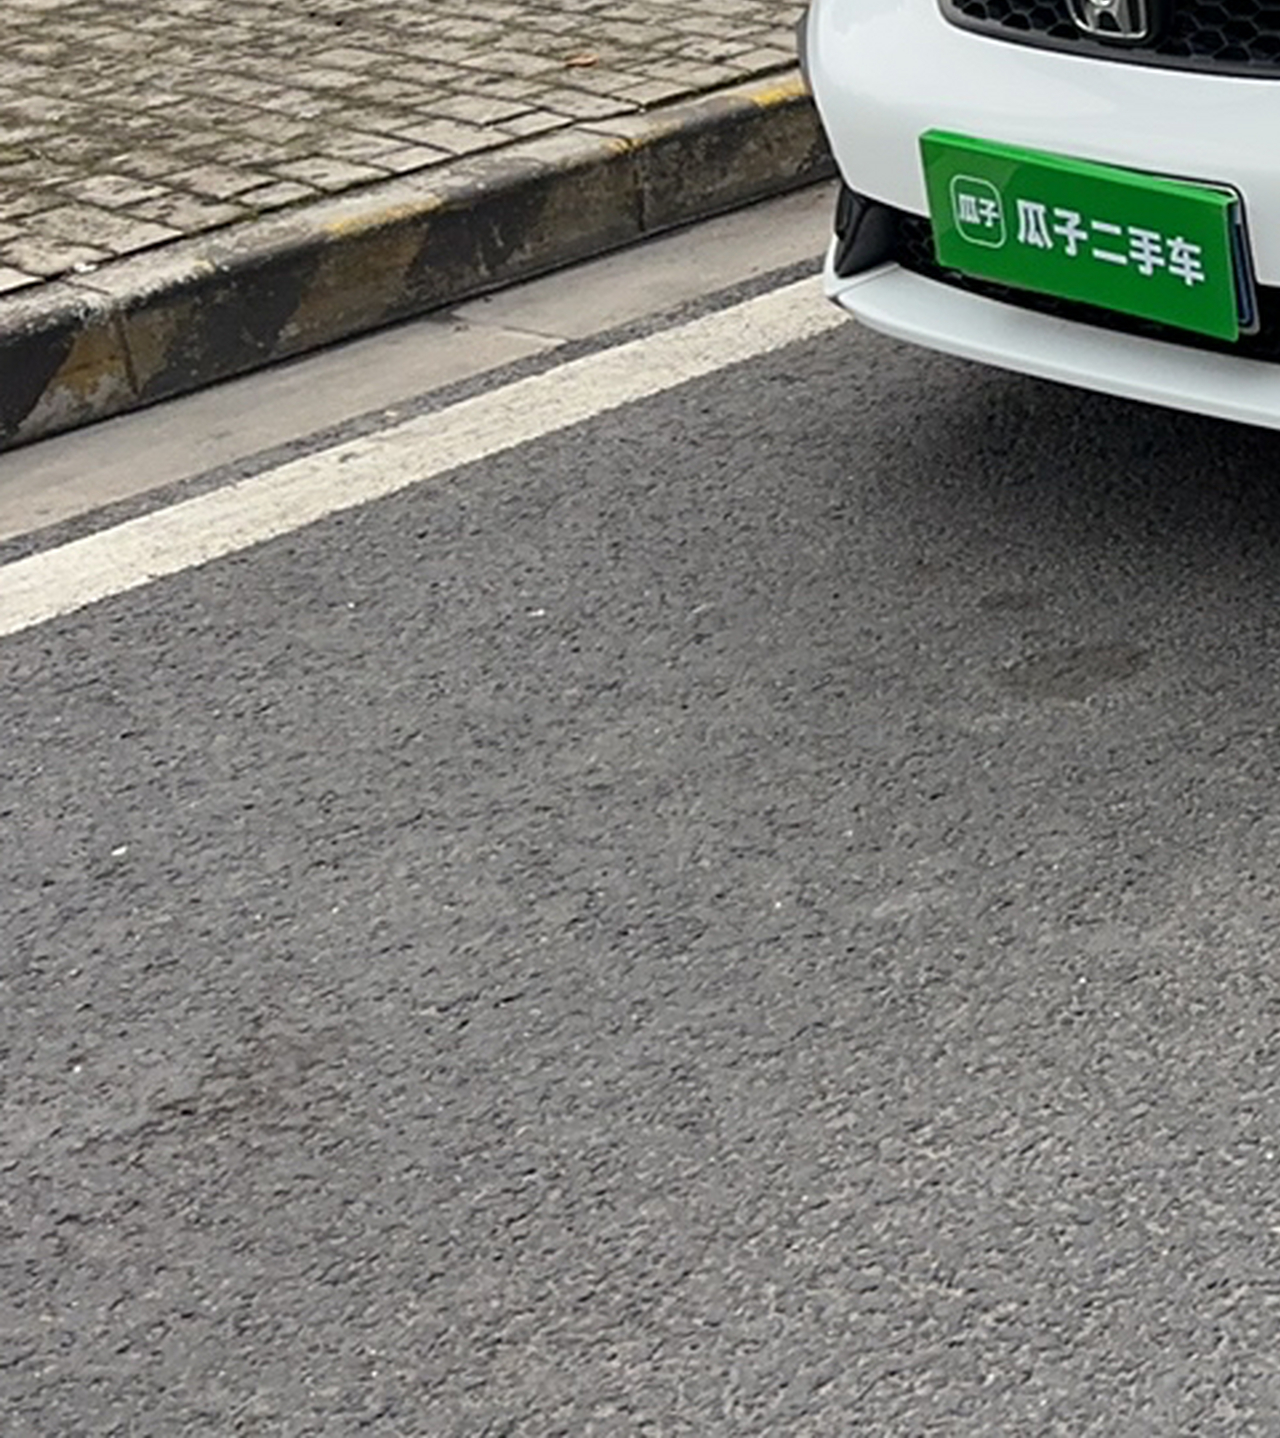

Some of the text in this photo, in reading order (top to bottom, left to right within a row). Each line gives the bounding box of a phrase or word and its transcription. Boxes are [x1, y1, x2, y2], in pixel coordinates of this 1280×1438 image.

[958, 193, 1000, 227] 瓜子
[1016, 199, 1205, 287] 瓜子二手车
